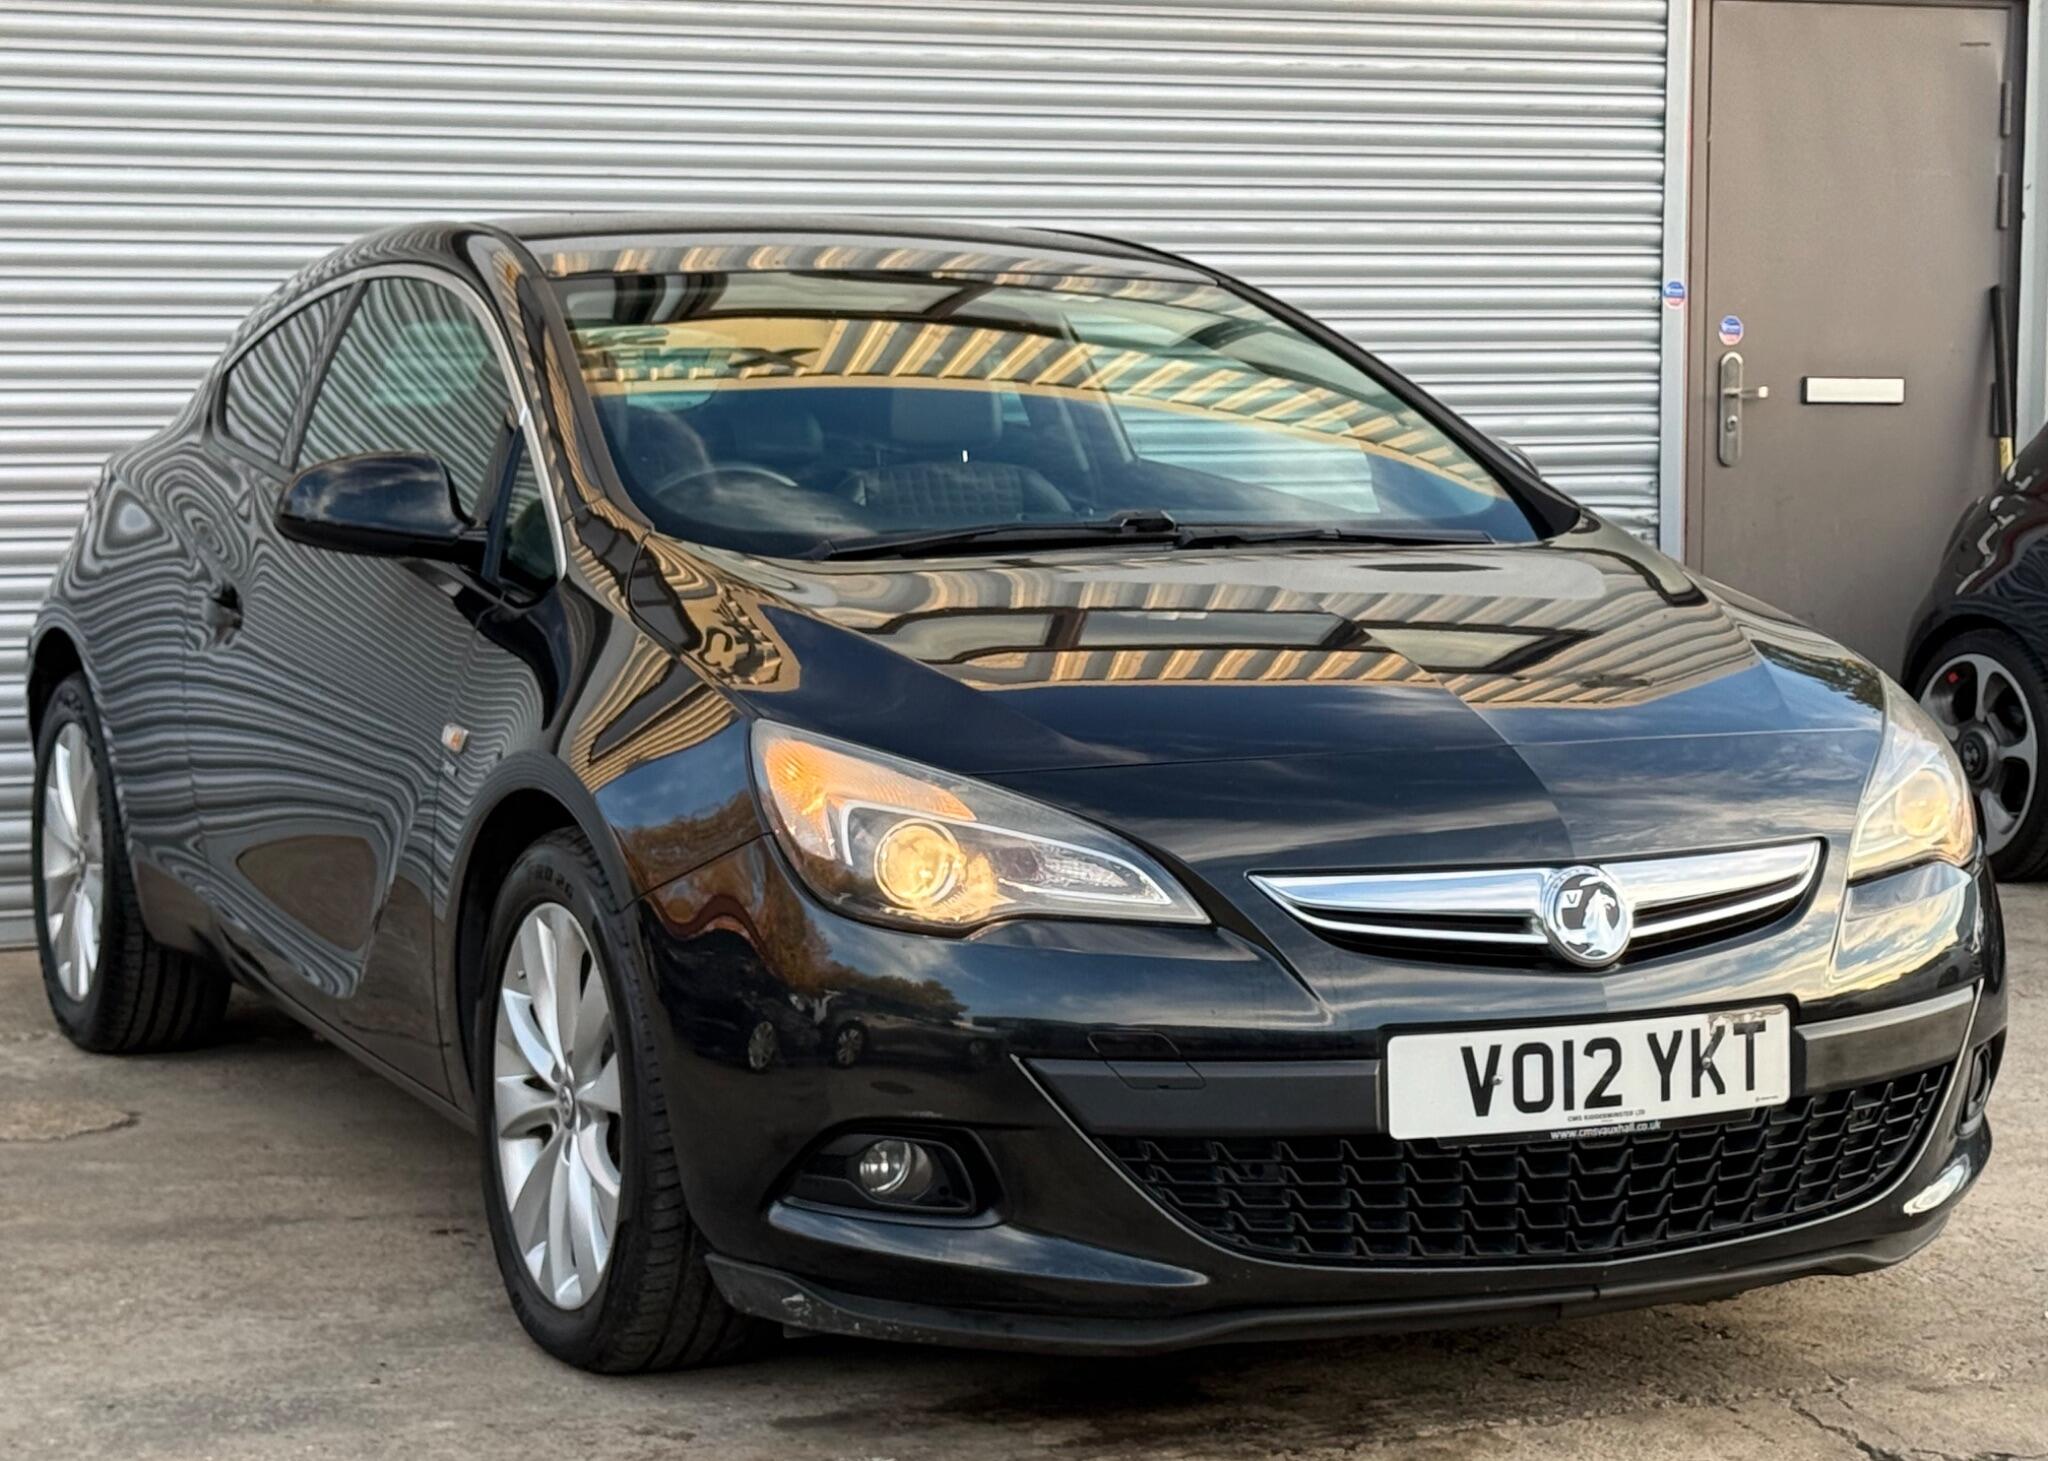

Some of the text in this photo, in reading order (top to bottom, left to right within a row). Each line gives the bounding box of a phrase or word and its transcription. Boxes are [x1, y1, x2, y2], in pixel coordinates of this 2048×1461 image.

[1460, 1019, 1767, 1118] VO12 YKT
[1550, 1120, 1661, 1140] www.cmsvauxhall.co.uk
